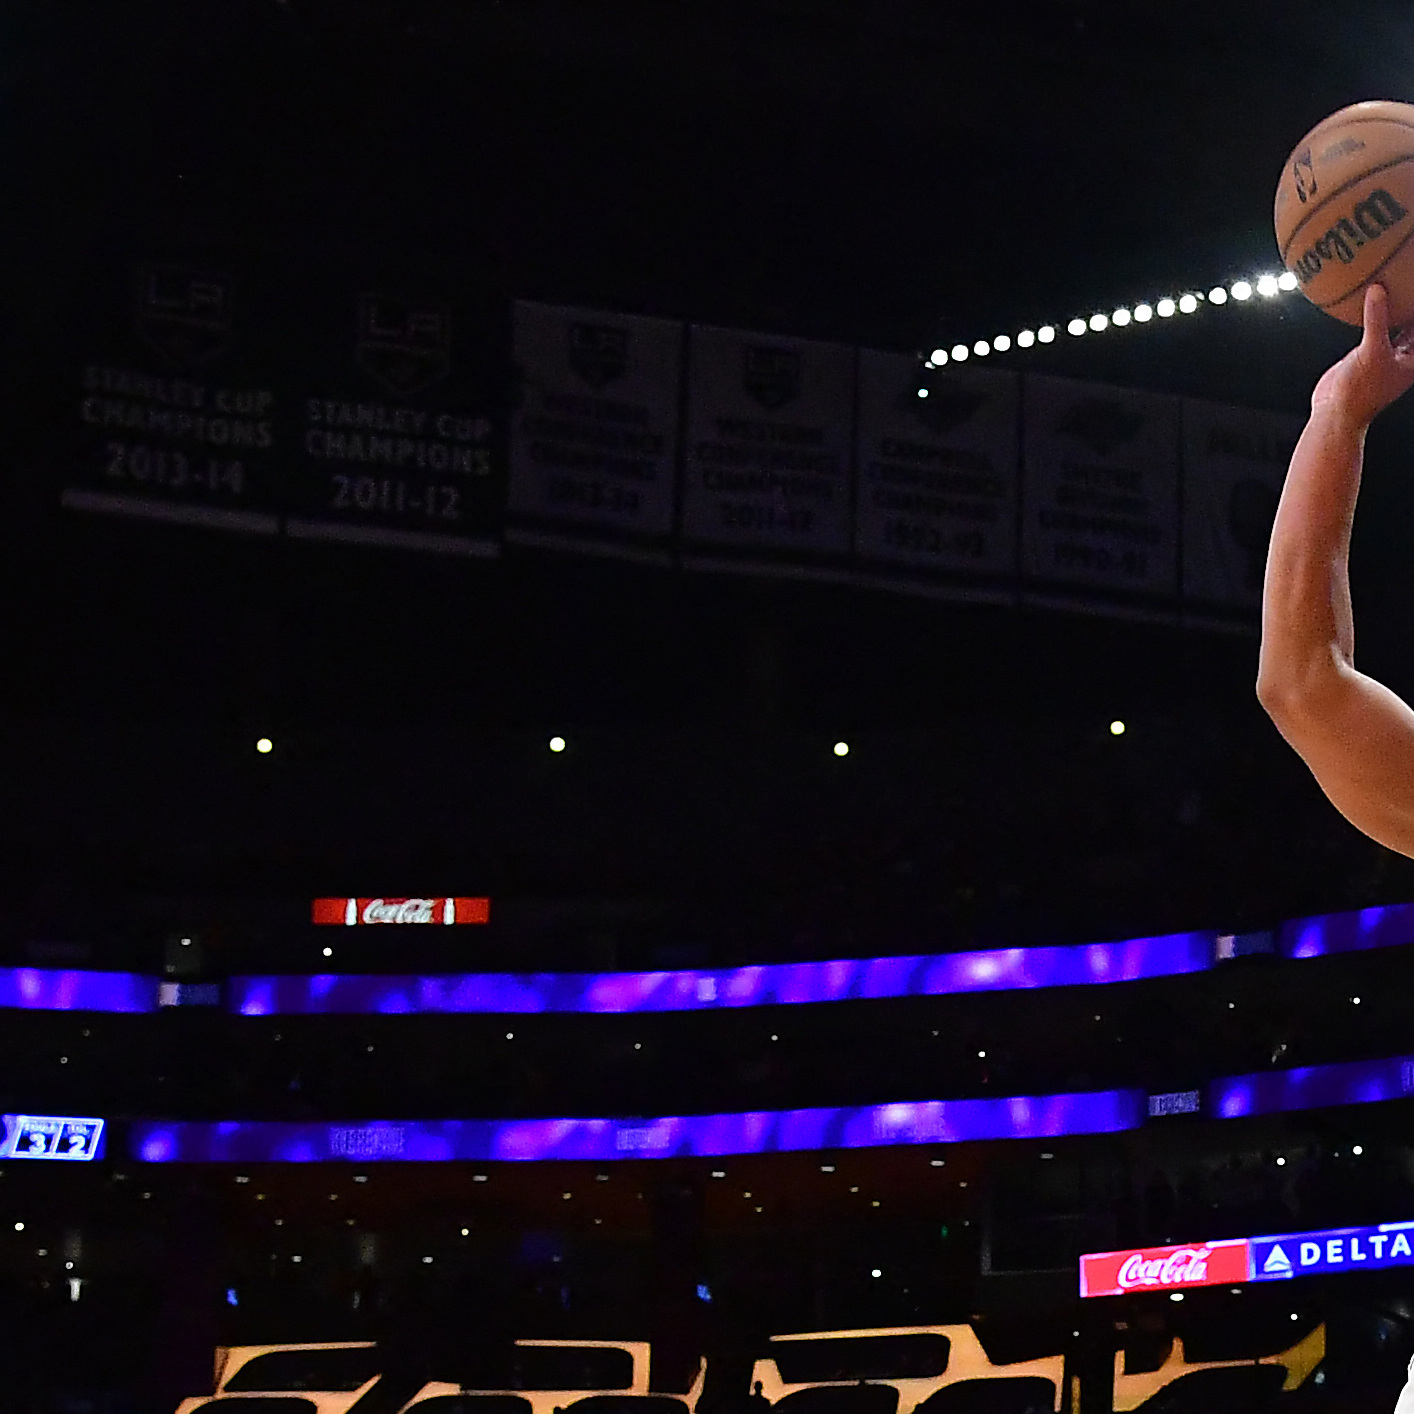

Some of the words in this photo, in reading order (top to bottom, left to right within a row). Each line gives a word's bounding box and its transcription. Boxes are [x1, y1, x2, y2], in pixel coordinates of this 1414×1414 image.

[1293, 189, 1408, 283] Wilson
[305, 427, 493, 477] CHAMPIONS
[29, 1133, 46, 1155] 3
[68, 1135, 86, 1157] 2
[1299, 1232, 1413, 1267] DELTA
